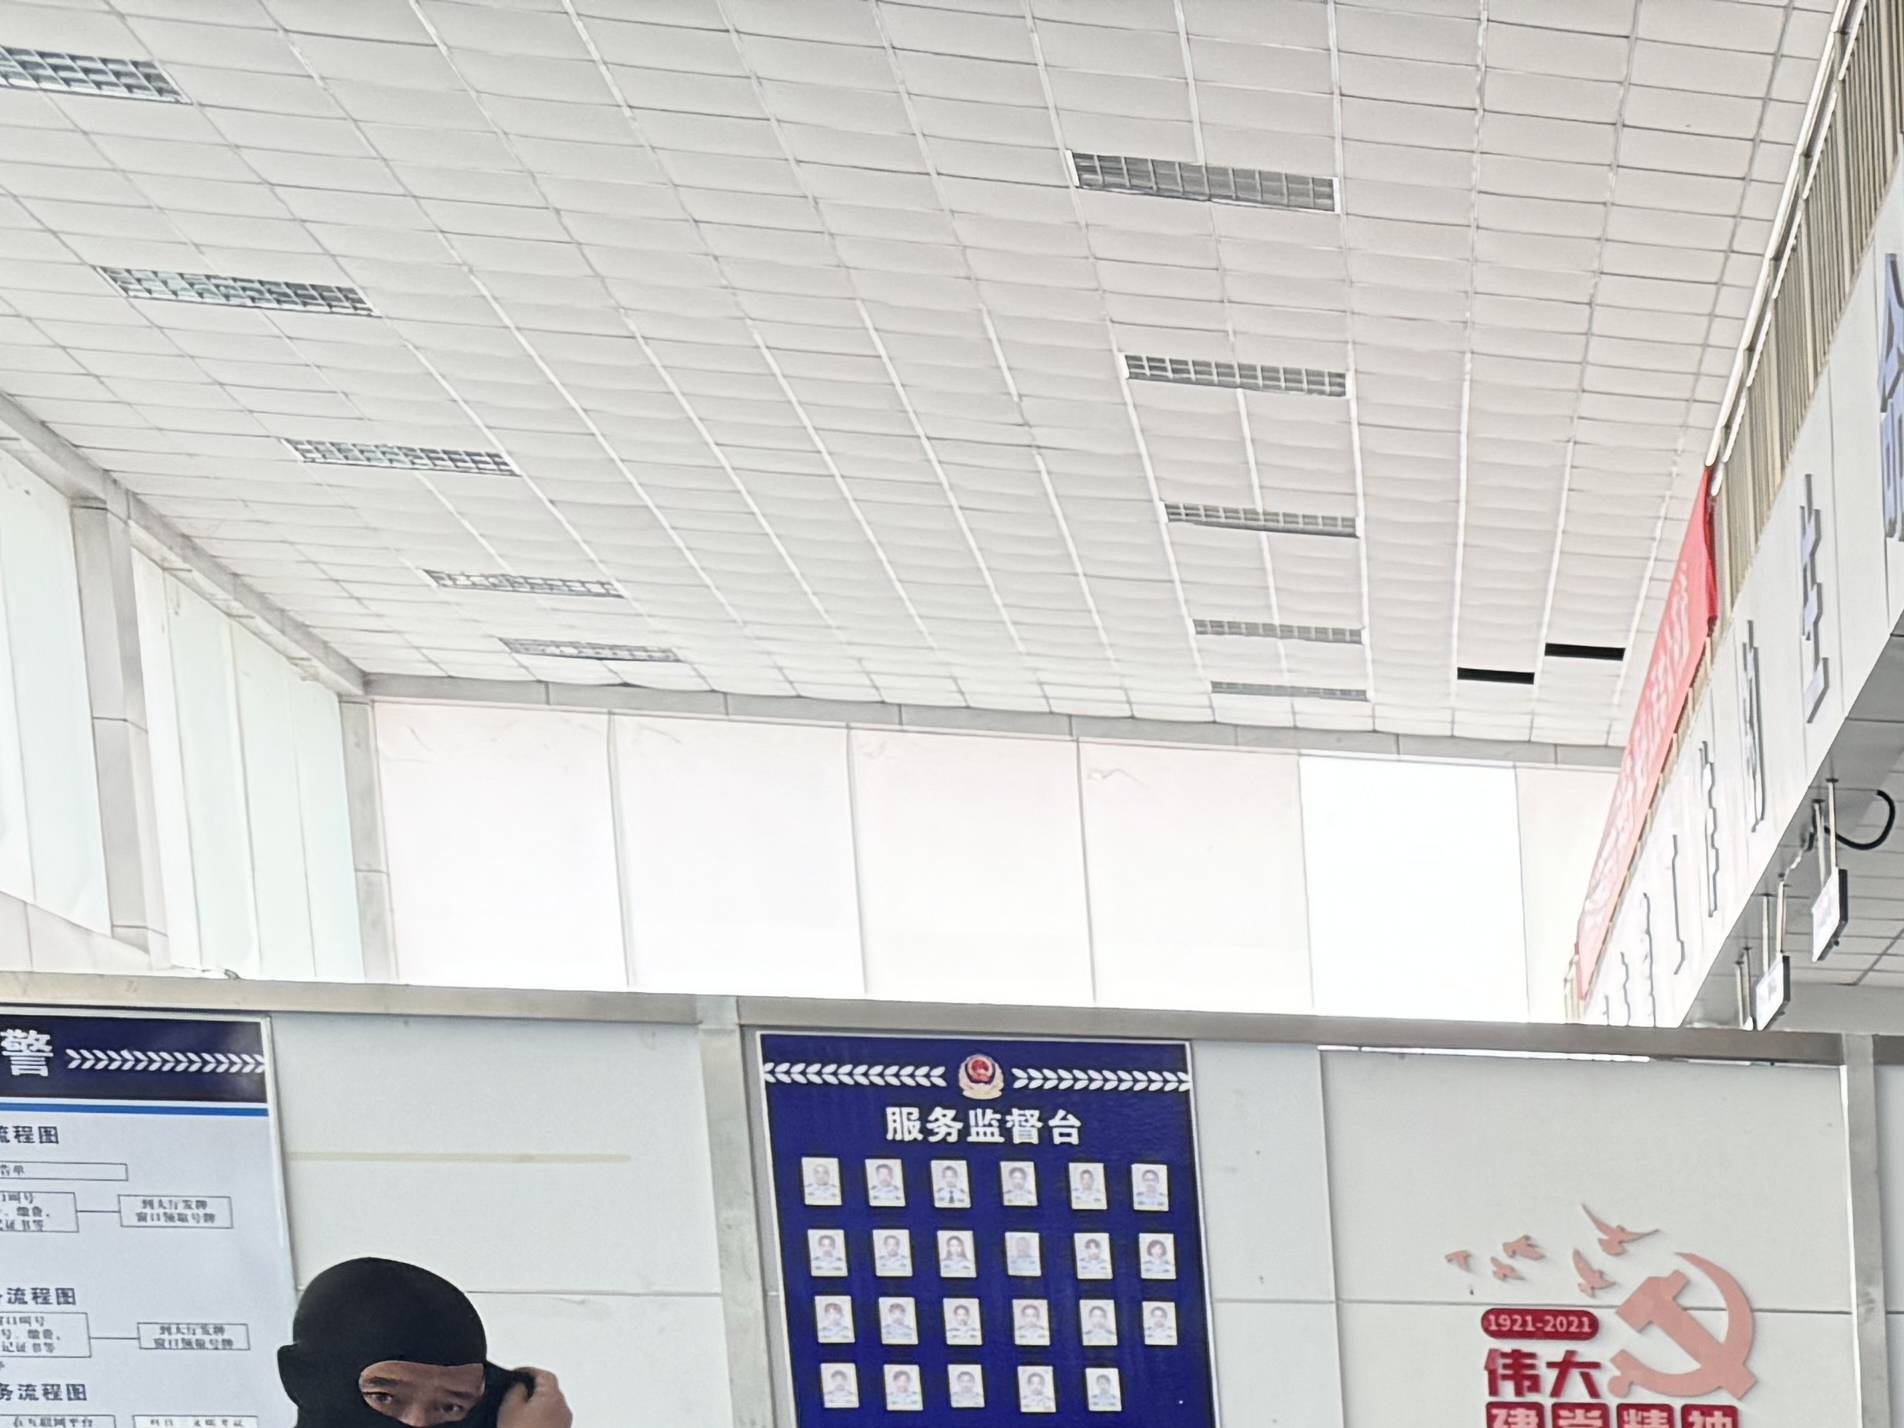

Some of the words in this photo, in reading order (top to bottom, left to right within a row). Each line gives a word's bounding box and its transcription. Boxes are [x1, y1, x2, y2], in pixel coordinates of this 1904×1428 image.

[885, 1105, 1082, 1145] 服务监督台
[1487, 1313, 1593, 1334] 1921-2021
[1483, 1348, 1602, 1400] 伟大
